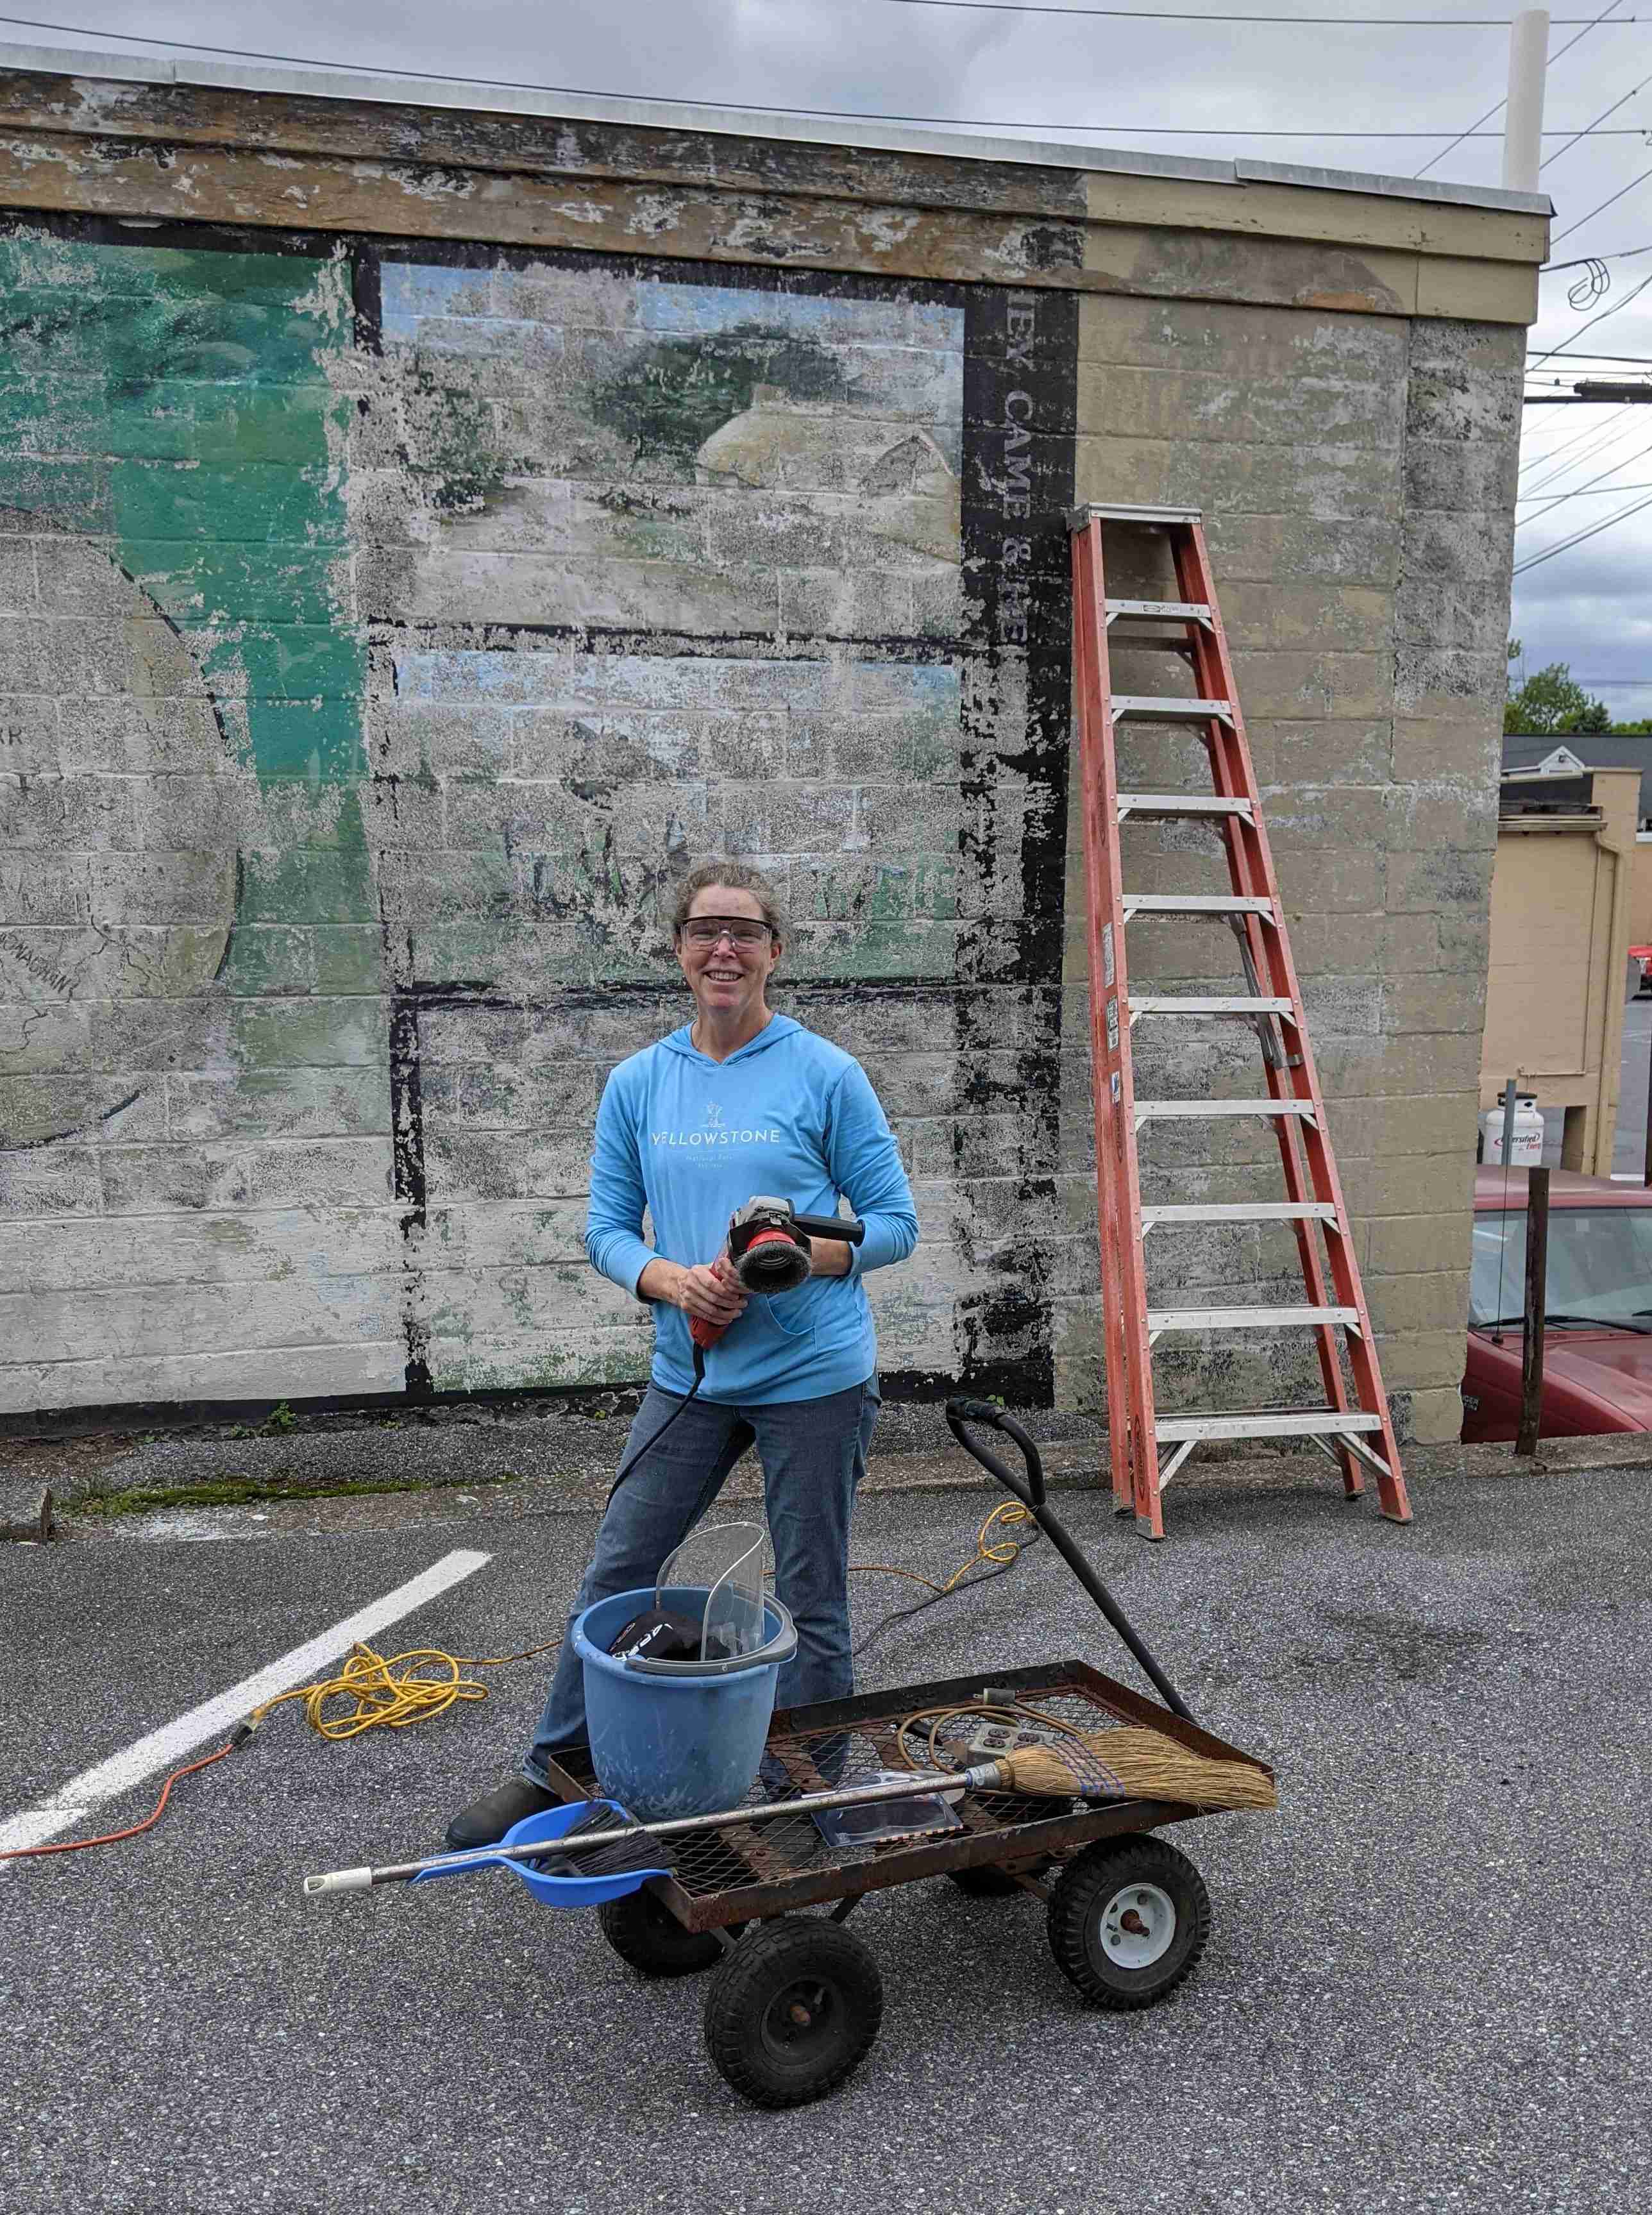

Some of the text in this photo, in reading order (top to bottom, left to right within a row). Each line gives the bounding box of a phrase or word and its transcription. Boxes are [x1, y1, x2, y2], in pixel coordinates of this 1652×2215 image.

[1002, 389, 1034, 519] CAME
[0, 932, 72, 994] ONAGHAN
[651, 1129, 780, 1145] YELLOWSTONE
